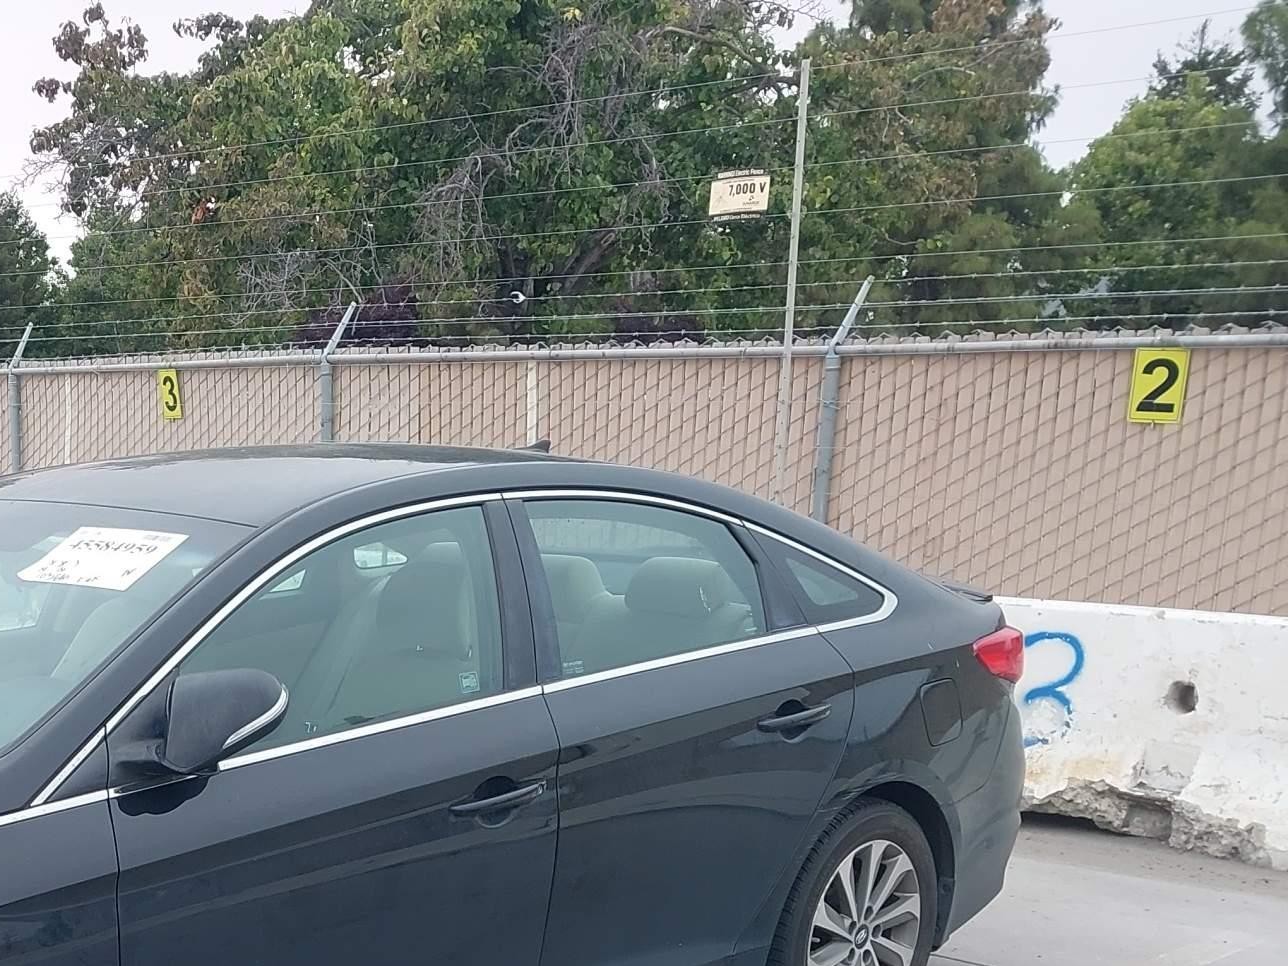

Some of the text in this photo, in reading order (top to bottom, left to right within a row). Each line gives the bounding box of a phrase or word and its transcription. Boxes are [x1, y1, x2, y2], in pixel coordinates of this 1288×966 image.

[728, 182, 756, 197] 7,000
[759, 181, 767, 193] V
[162, 375, 178, 412] 3
[1135, 358, 1180, 413] 2
[69, 539, 159, 554] 45584959
